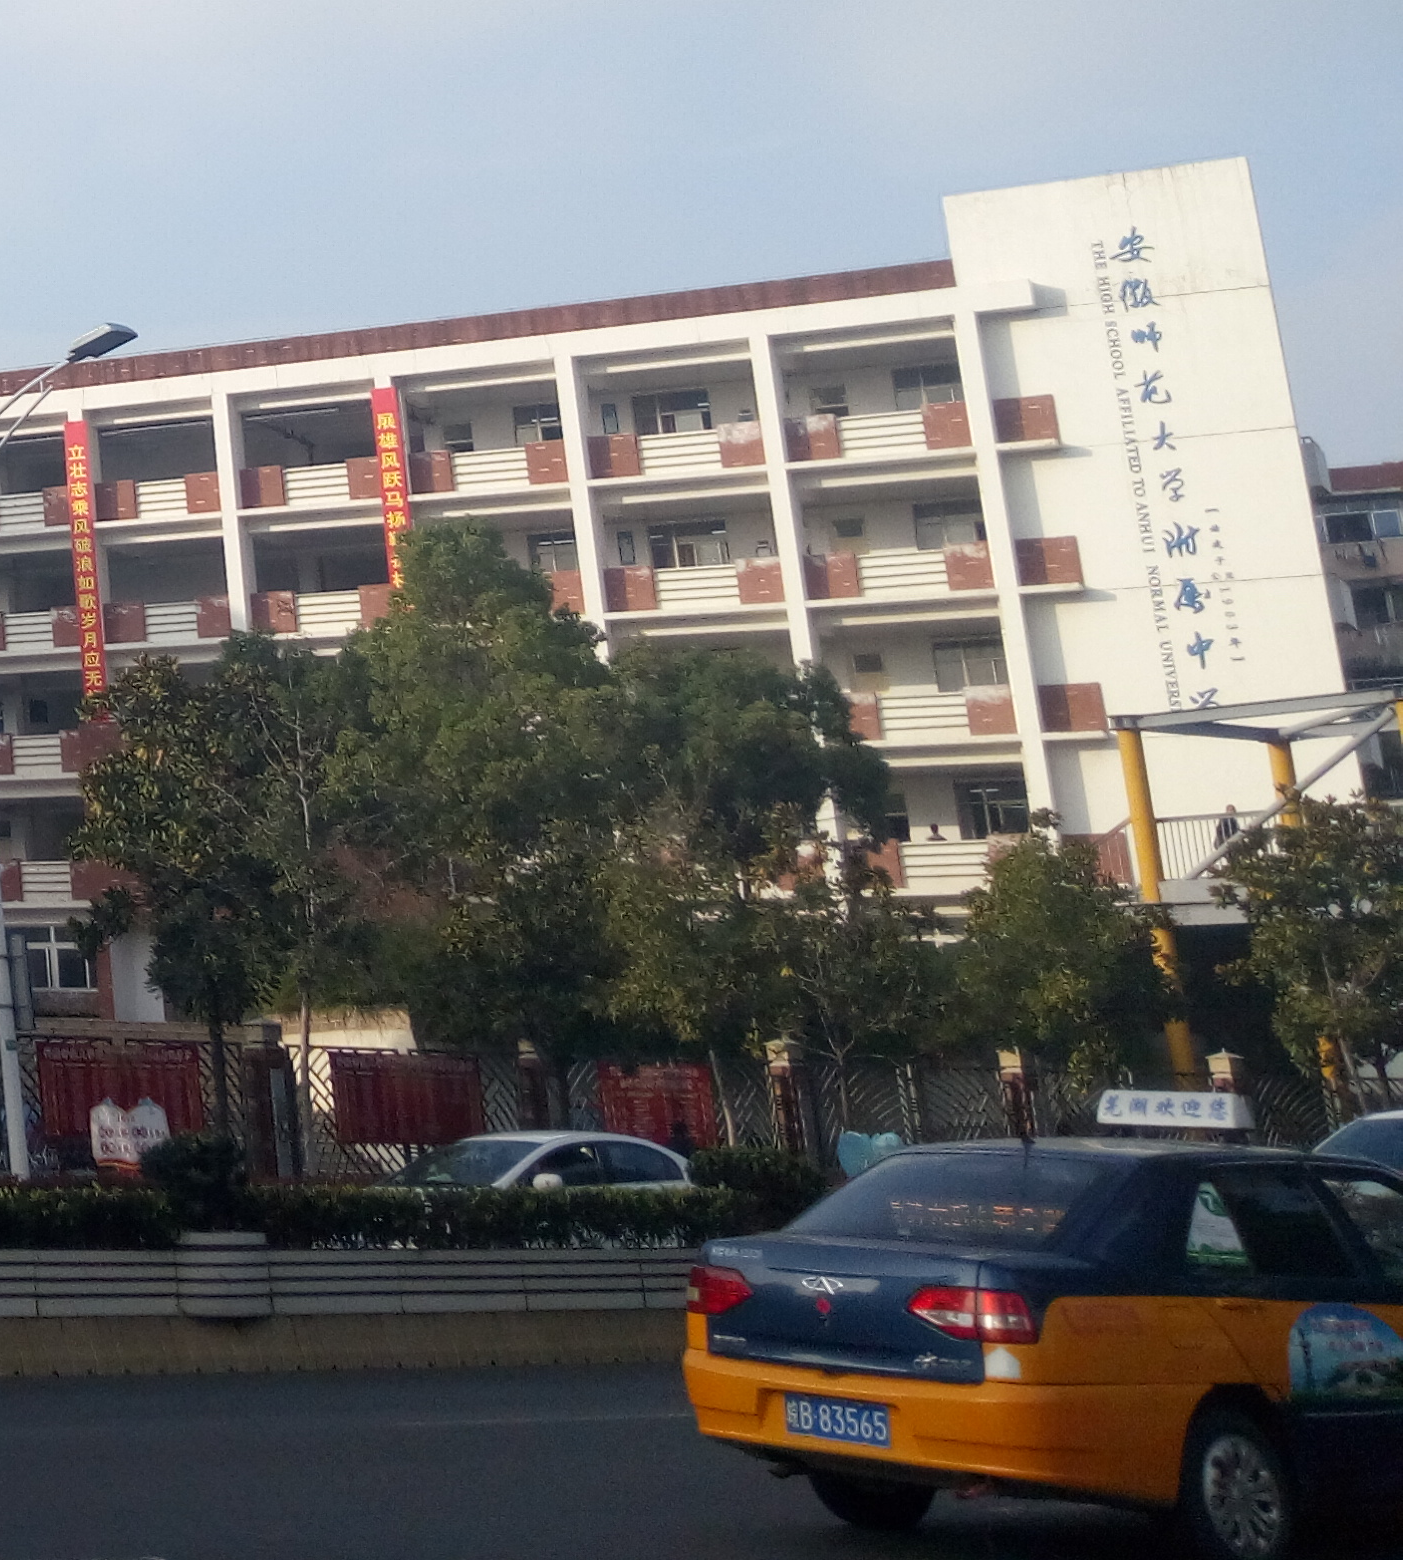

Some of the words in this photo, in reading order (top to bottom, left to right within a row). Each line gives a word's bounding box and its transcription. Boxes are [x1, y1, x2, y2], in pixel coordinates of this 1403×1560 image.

[1092, 240, 1108, 270] THE
[1097, 276, 1115, 315] HIGH
[1105, 320, 1126, 380] SCHOOL
[1116, 388, 1142, 475] AFFILIATED
[1132, 478, 1146, 498] TO
[1135, 502, 1156, 554] ANHUI
[68, 444, 103, 697] 立壮志乘风破浪如歌岁月应无
[1146, 565, 1170, 632] NORMAL
[1103, 1094, 1228, 1121] 芜湖欢迎您
